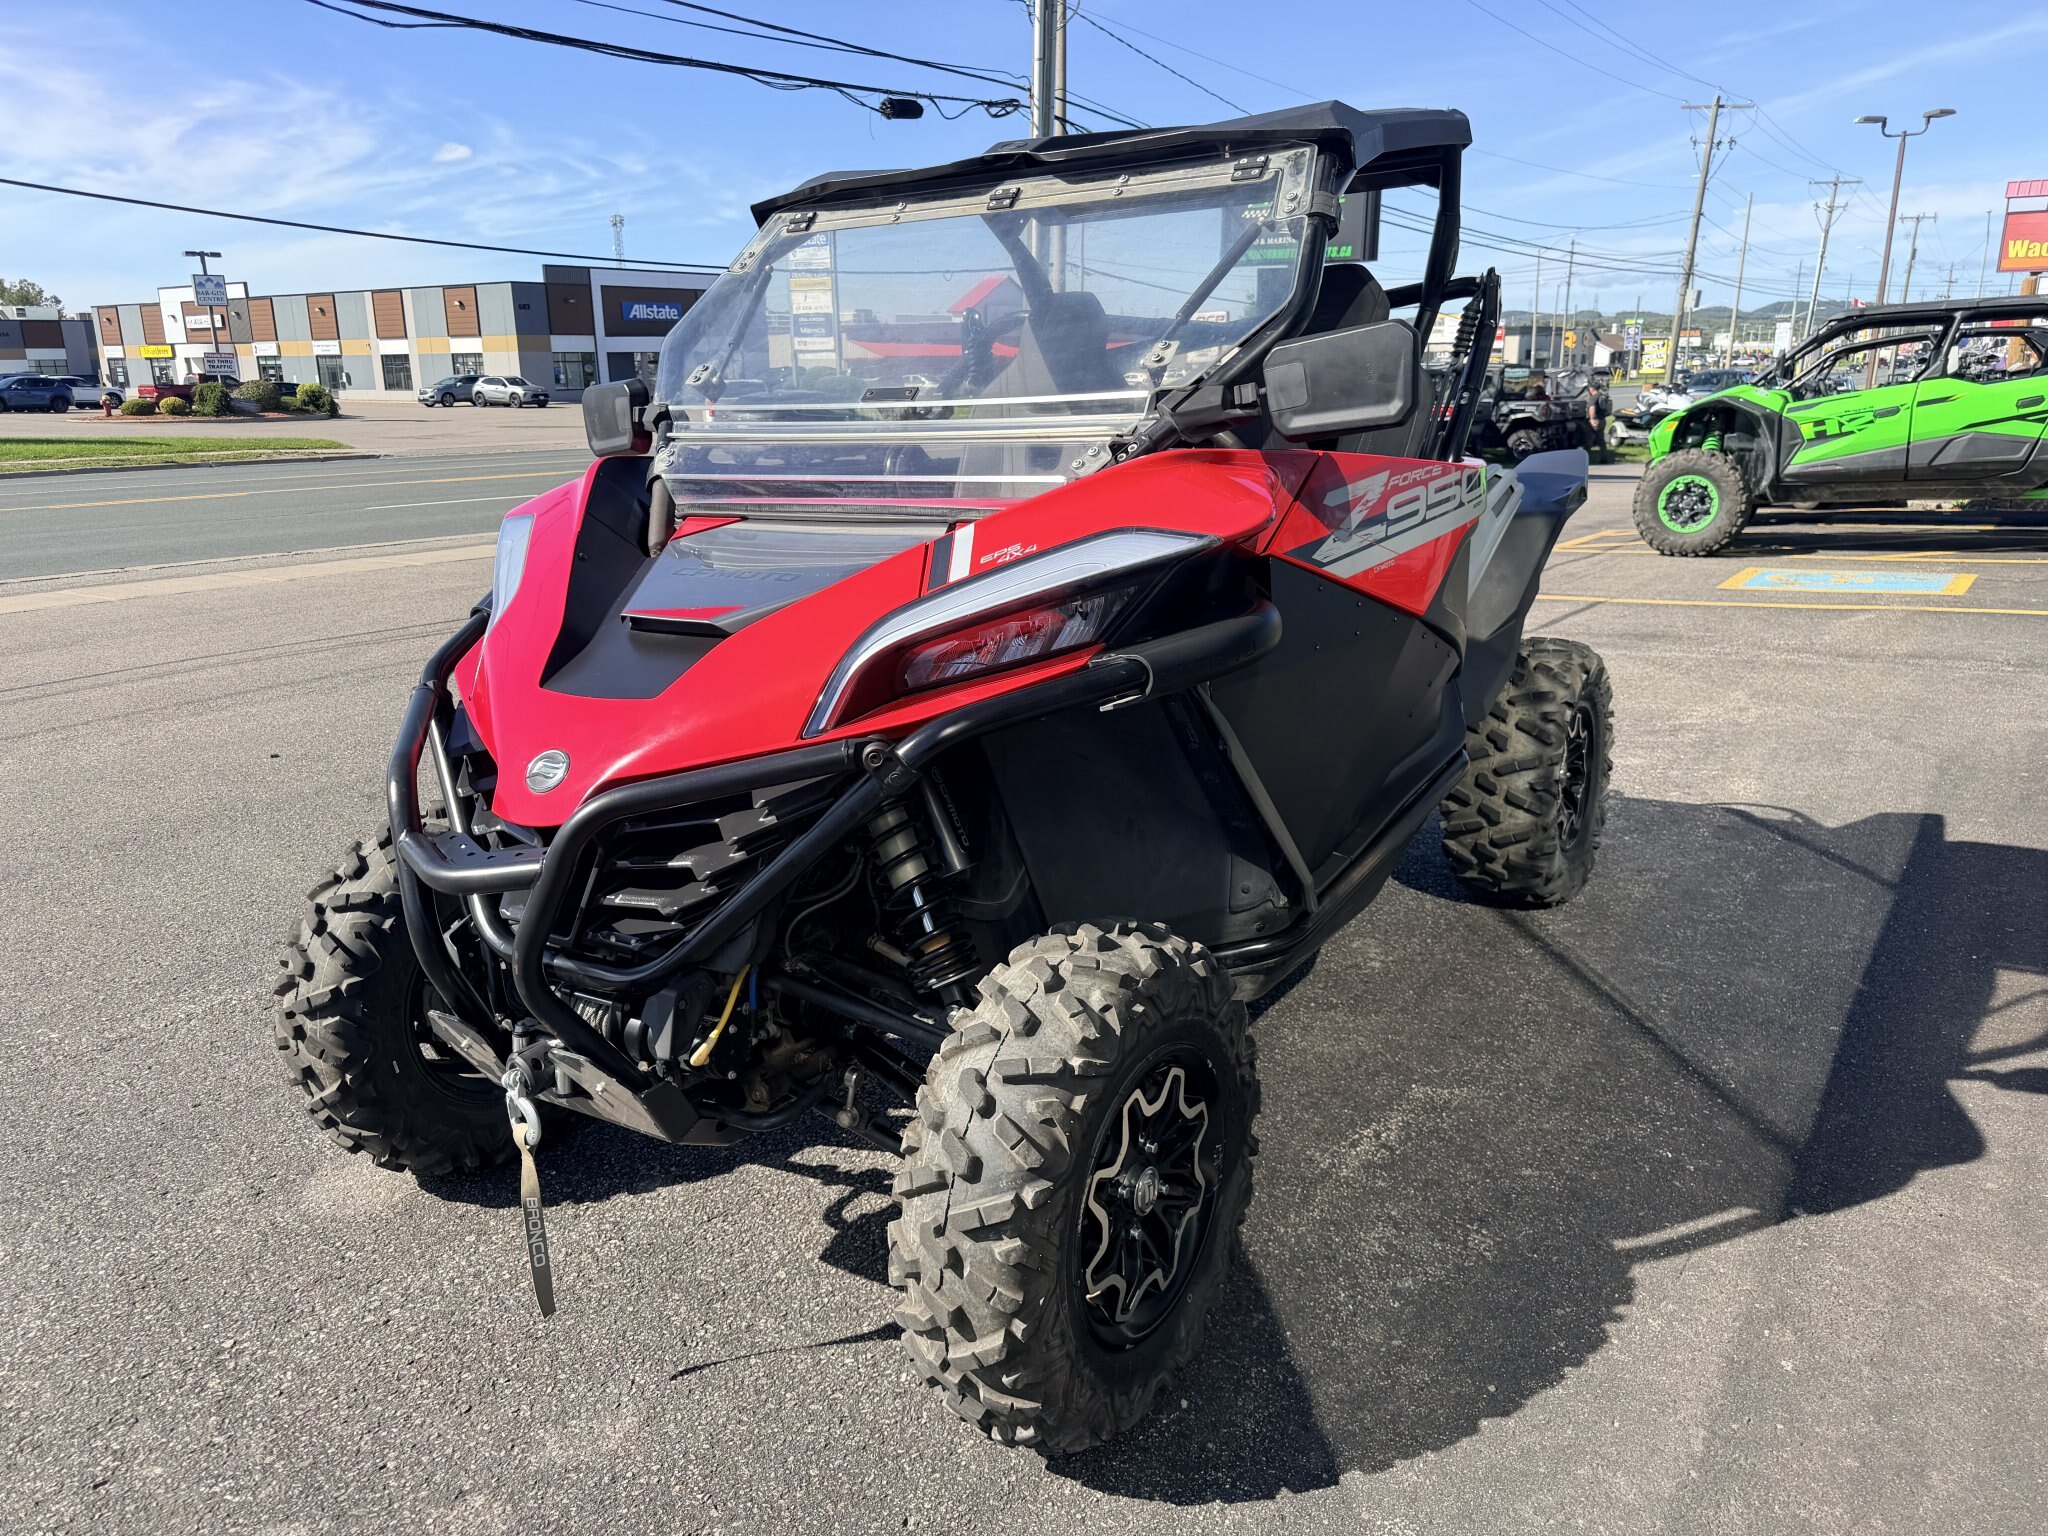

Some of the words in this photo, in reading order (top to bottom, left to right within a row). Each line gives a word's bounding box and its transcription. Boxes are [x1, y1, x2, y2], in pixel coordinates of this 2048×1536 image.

[629, 303, 679, 320] Allstate
[1386, 464, 1443, 490] FORCE
[980, 542, 1022, 564] EPS
[1373, 559, 1396, 574] CFMOTO
[525, 1197, 547, 1268] BRONCO
